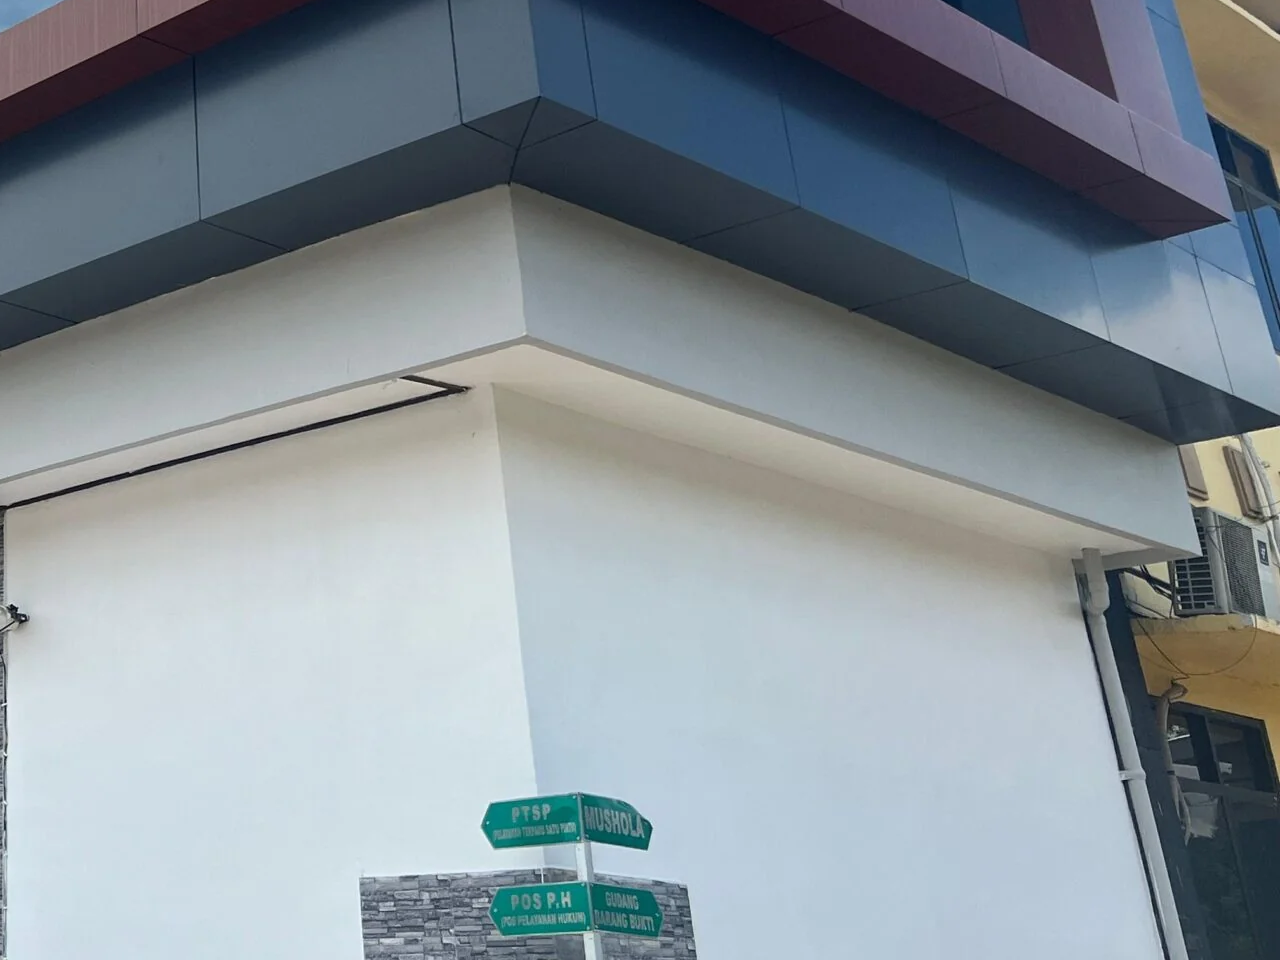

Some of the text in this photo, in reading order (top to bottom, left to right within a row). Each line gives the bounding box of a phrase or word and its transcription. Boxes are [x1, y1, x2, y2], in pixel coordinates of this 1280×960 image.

[512, 803, 551, 823] PTSP
[584, 805, 645, 838] MUSHOLA
[511, 891, 572, 910] POS P.H
[605, 891, 639, 910] GUDANG
